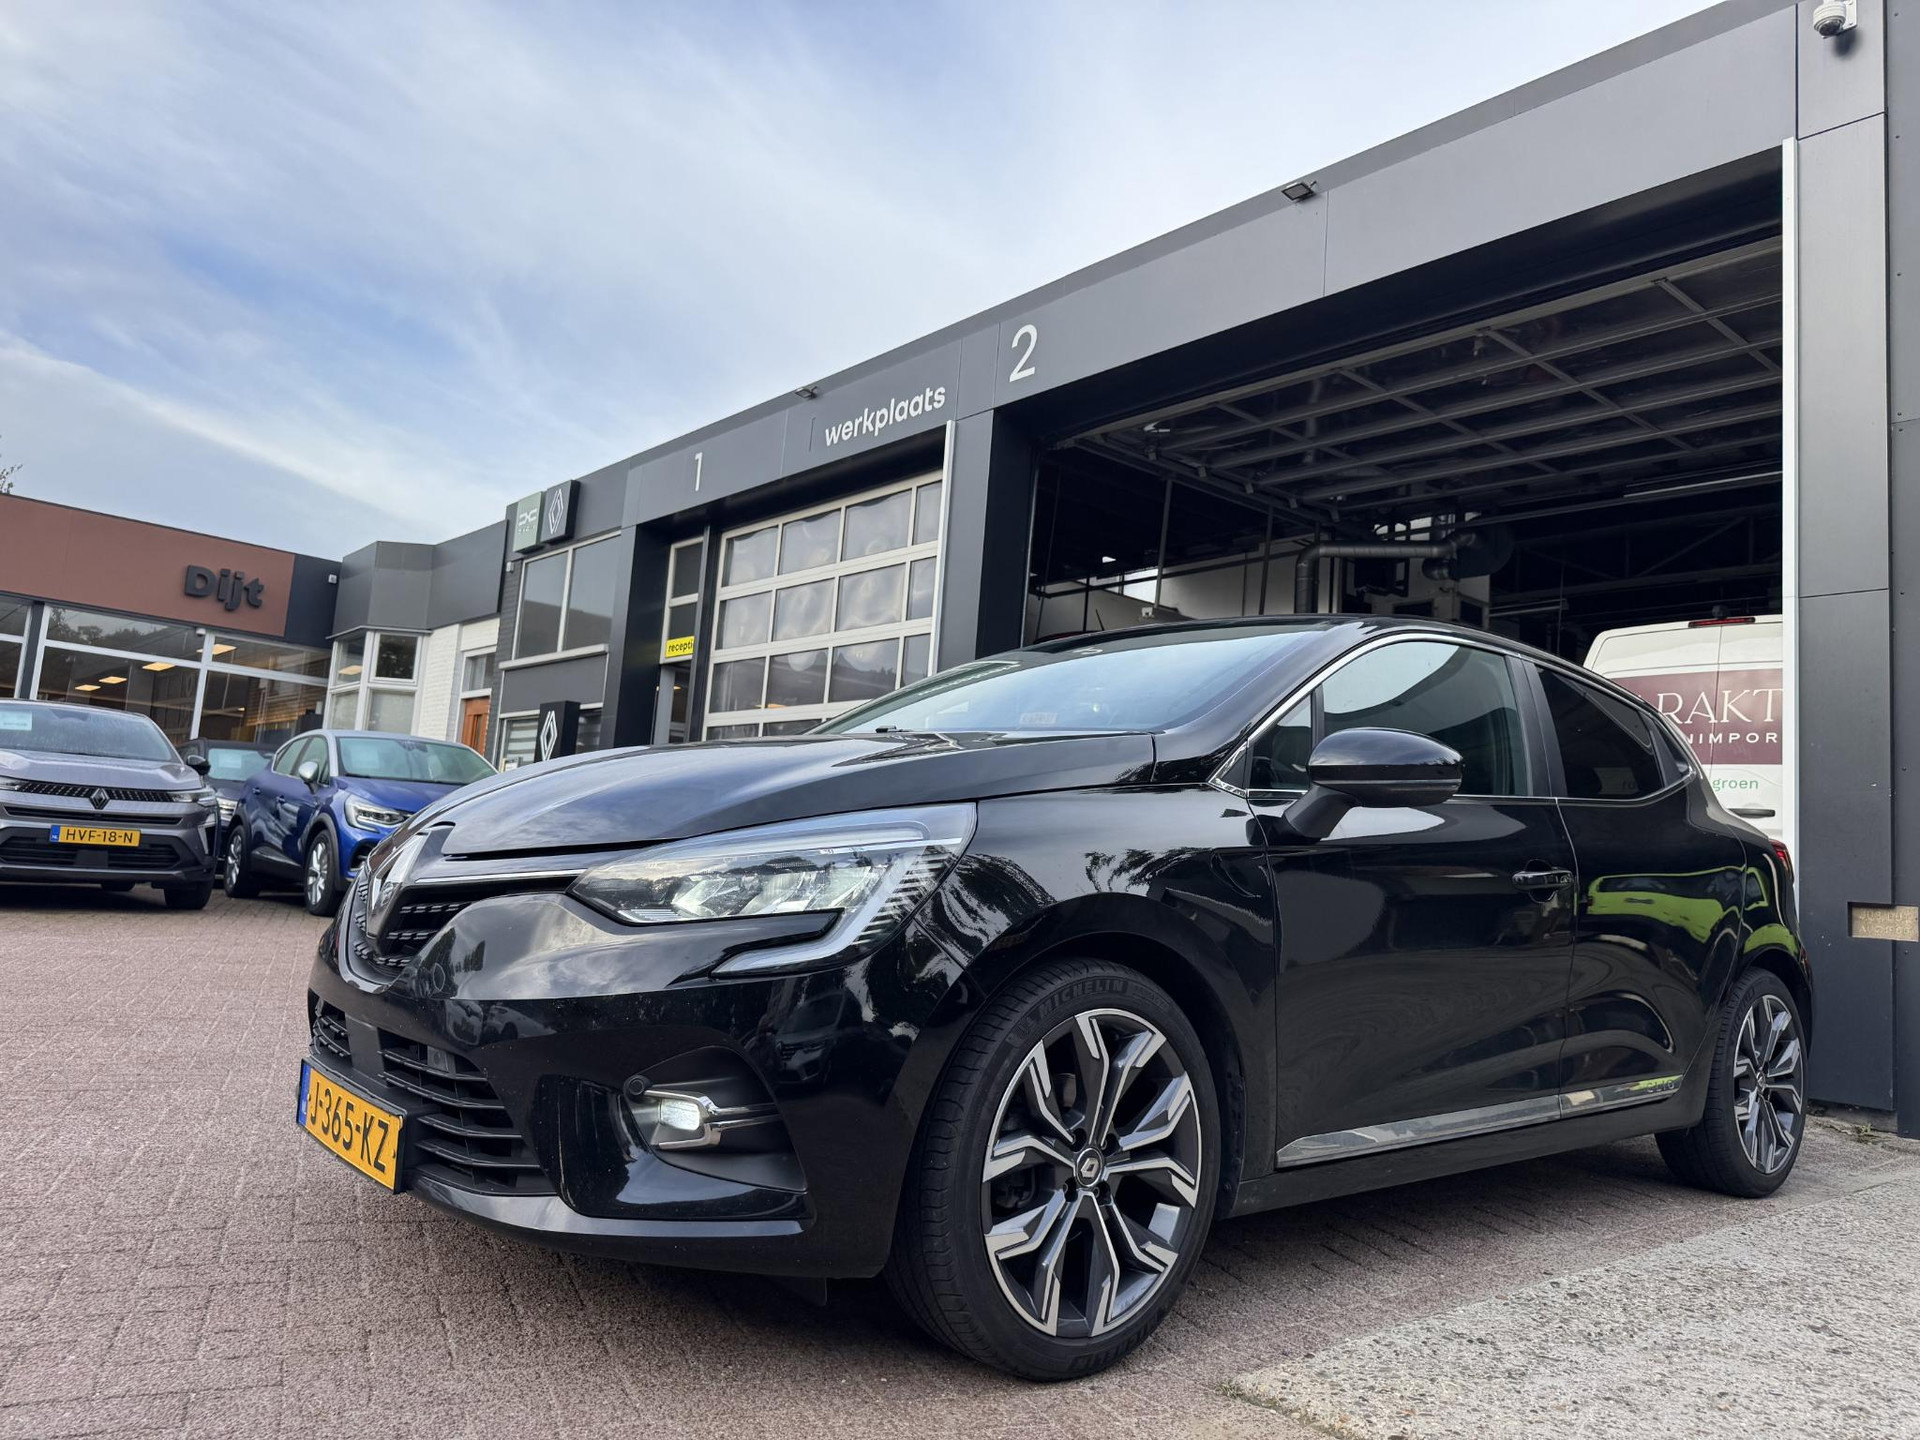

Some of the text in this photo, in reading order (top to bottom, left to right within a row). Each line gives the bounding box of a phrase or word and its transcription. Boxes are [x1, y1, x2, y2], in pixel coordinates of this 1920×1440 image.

[1008, 324, 1038, 382] 2
[824, 385, 946, 447] werkplaats
[694, 451, 703, 492] 1
[184, 564, 264, 612] Dijt
[1639, 688, 1783, 724] RAKT
[1712, 777, 1759, 792] groen
[66, 828, 133, 844] HVF-18-N
[310, 1081, 390, 1174] J-365-KZ
